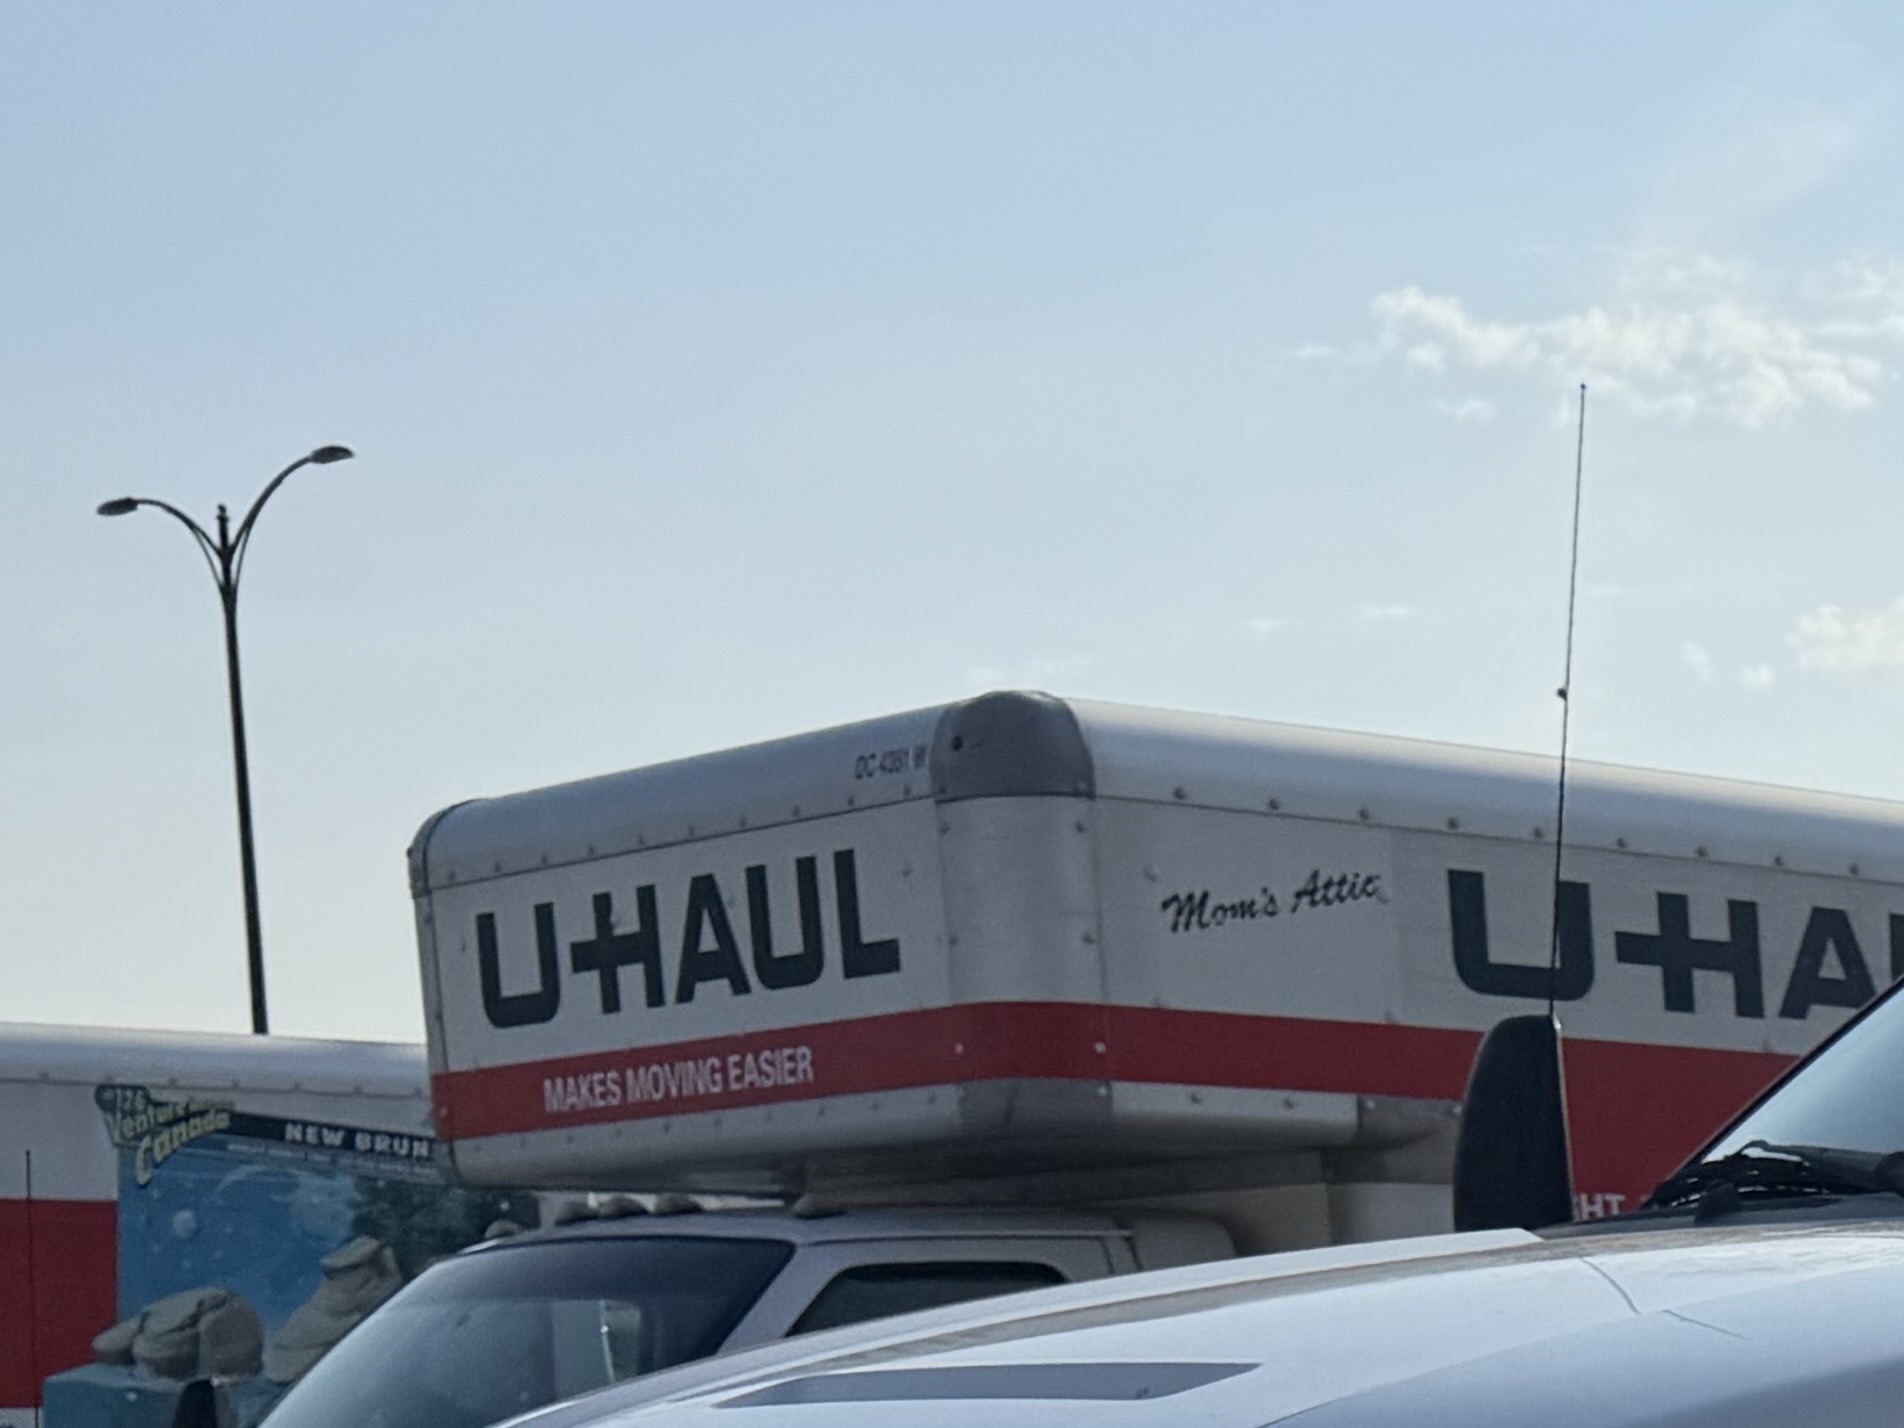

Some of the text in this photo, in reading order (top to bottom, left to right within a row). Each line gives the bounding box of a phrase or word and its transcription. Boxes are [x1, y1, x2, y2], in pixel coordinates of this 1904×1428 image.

[1161, 869, 1382, 934] Mom's Attic
[475, 848, 901, 1028] U-HAUL
[543, 1046, 814, 1113] MAKES MOVING EASIER
[285, 1122, 431, 1158] NEW BRUN
